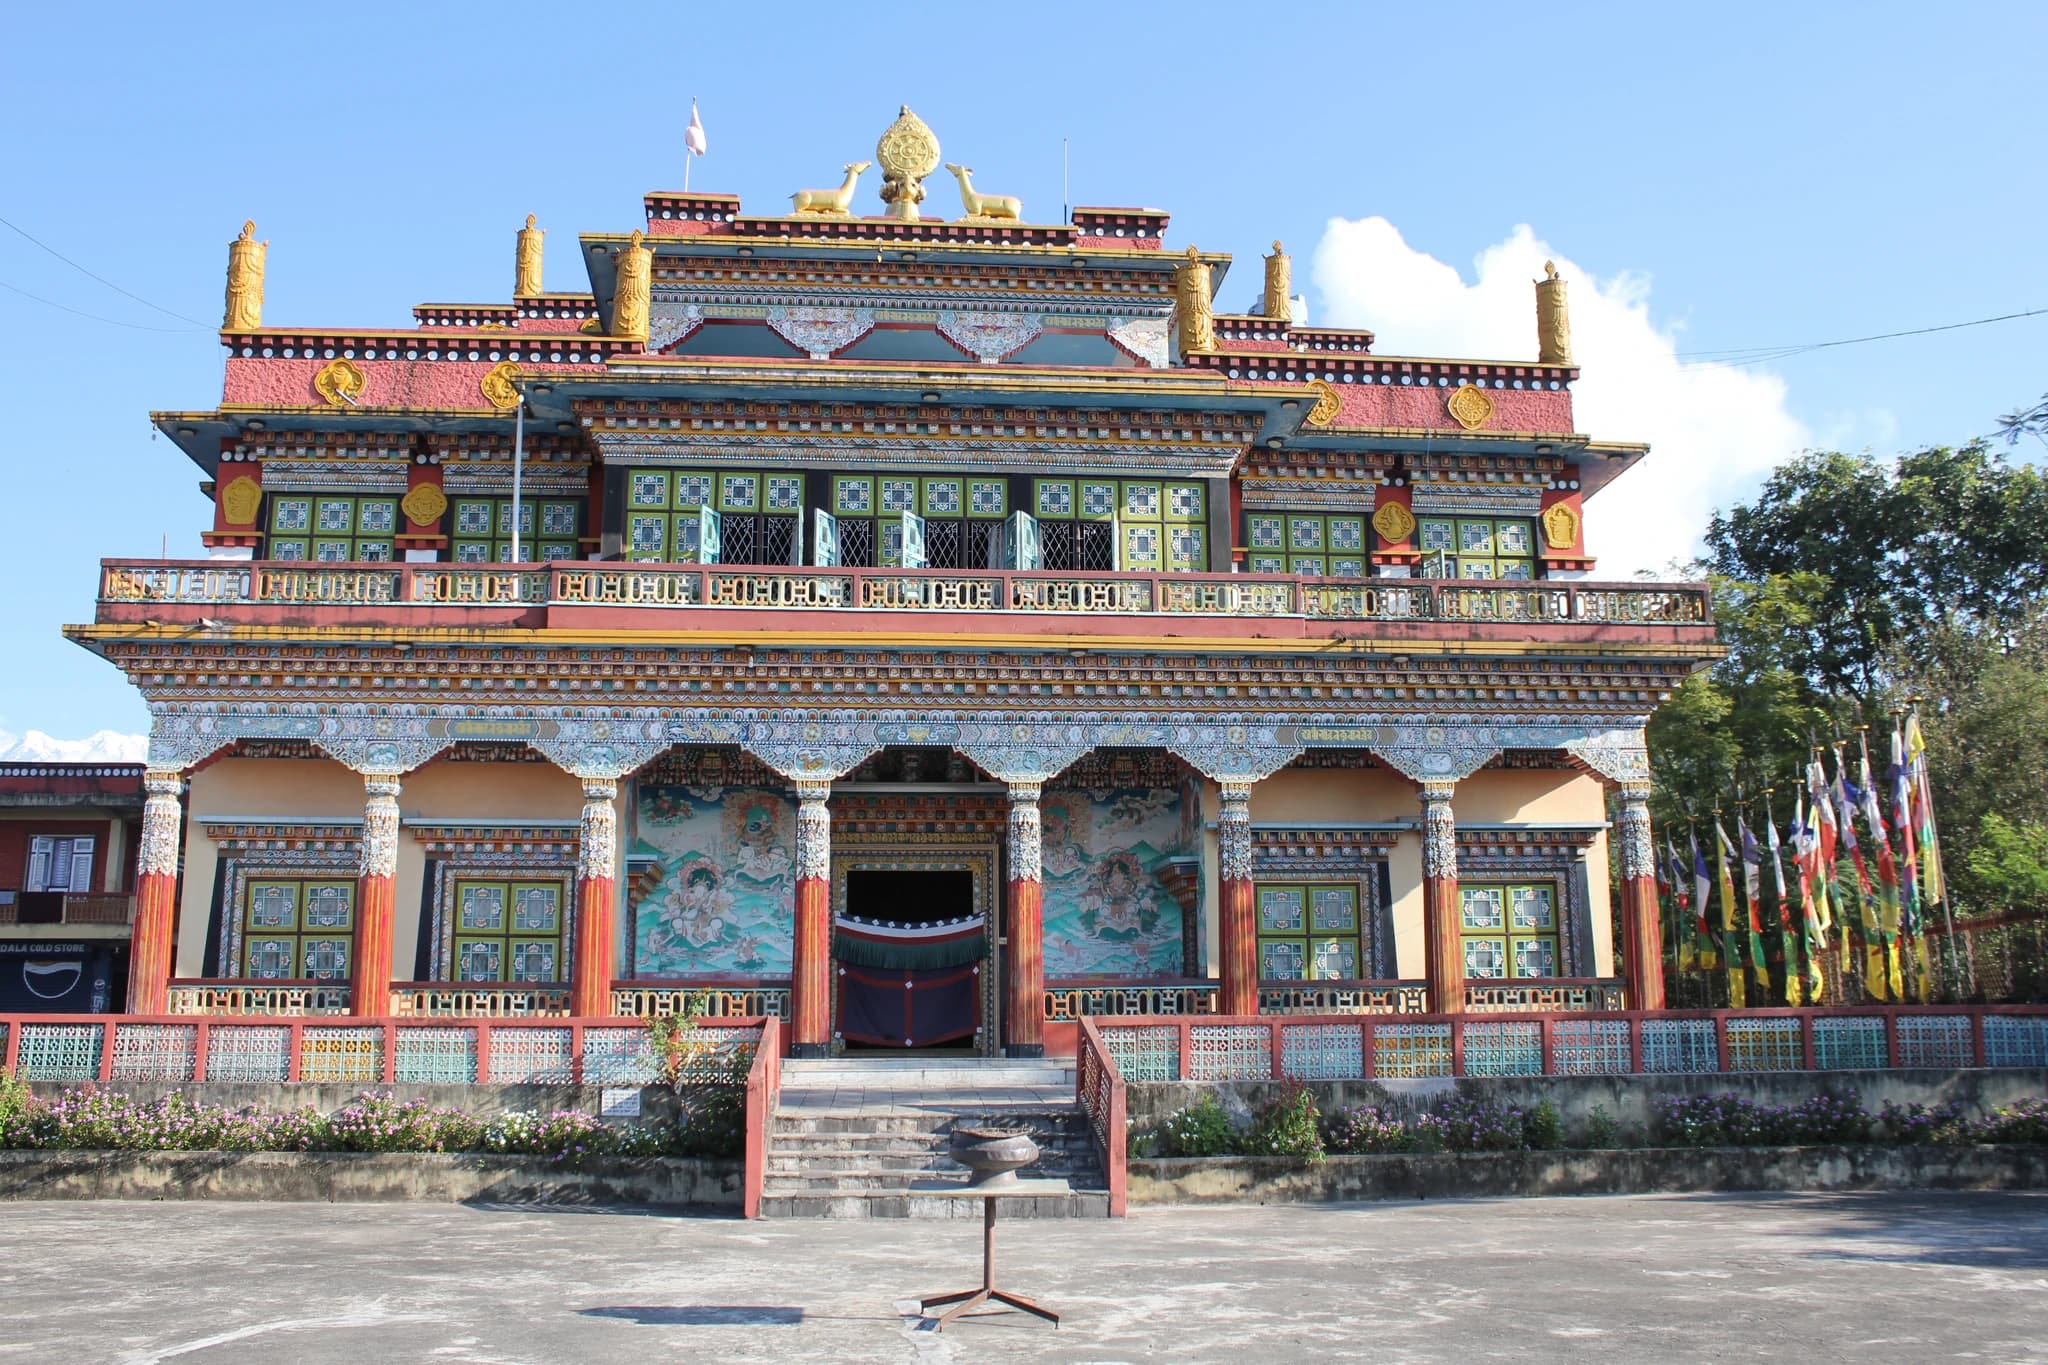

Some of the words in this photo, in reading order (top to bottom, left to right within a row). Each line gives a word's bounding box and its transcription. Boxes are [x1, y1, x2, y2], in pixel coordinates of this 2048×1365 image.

[0, 944, 27, 952] DALA
[29, 944, 53, 952] COLD
[53, 944, 85, 952] STORE
